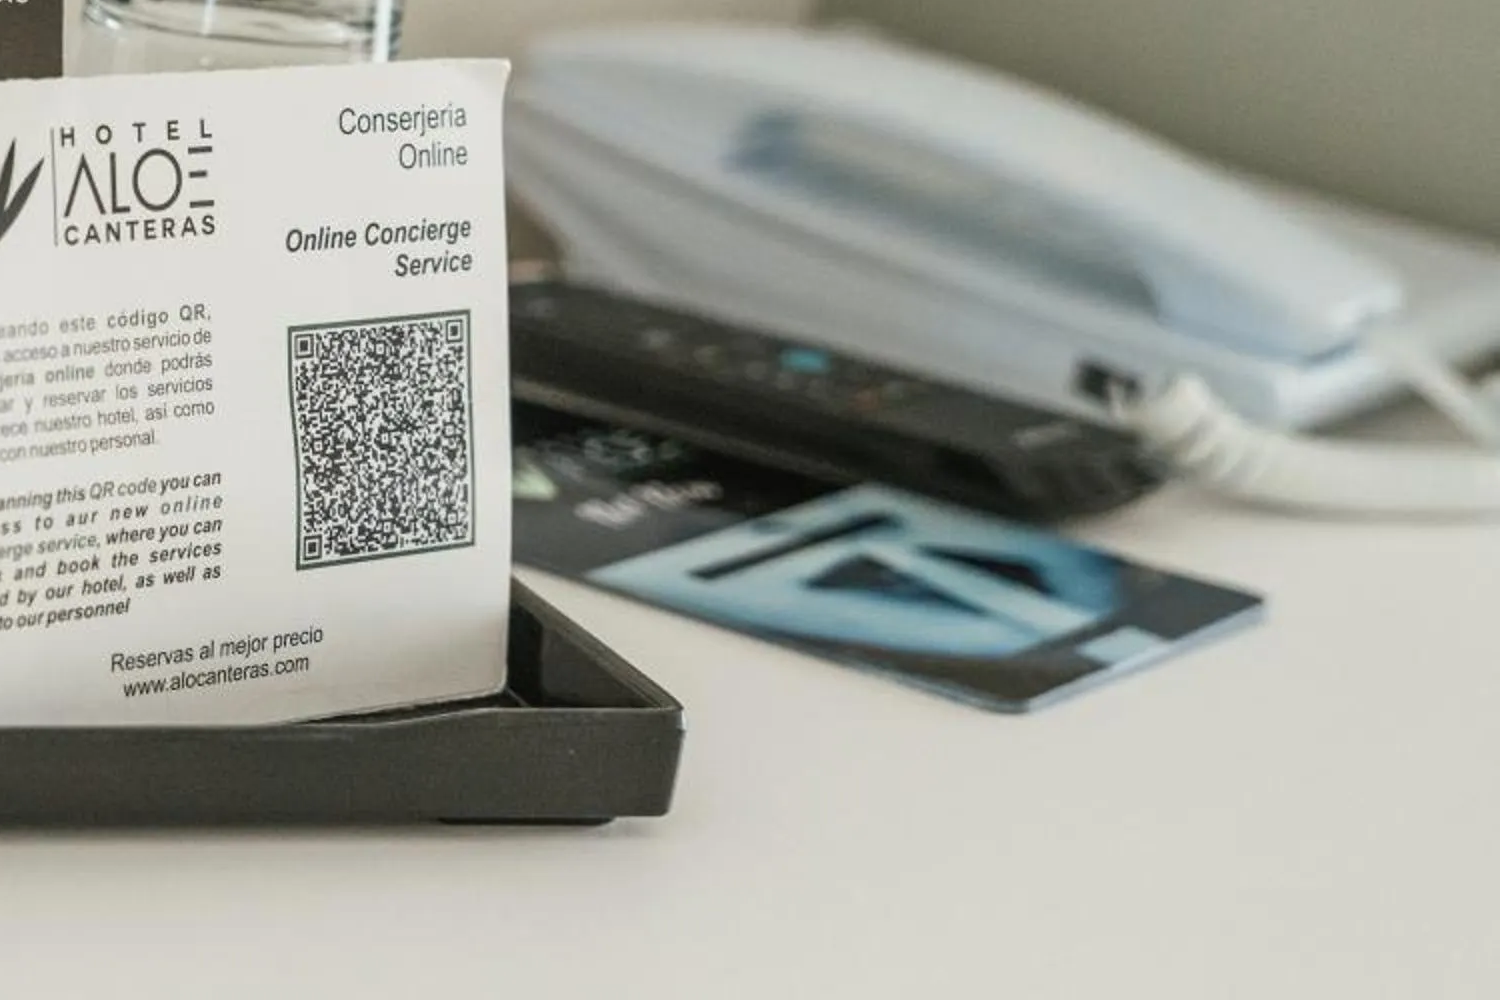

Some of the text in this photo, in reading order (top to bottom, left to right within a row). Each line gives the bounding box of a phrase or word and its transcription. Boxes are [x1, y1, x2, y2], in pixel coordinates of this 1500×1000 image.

[60, 118, 213, 147] HOTEL
[399, 142, 468, 170] Online
[64, 146, 215, 218] ALOE
[64, 215, 216, 246] CANTERAS
[286, 219, 471, 253] Online Concierge
[395, 250, 473, 277] Service
[59, 315, 96, 334] este
[3, 344, 58, 363] acceso
[73, 338, 131, 358] nuestro
[133, 330, 191, 351] servicio
[193, 328, 212, 345] de
[45, 365, 95, 384] online
[104, 358, 152, 378] donde
[161, 352, 213, 374] podrás
[23, 396, 34, 415] y
[43, 388, 107, 408] reservar
[115, 384, 138, 401] los
[147, 376, 213, 398] servicios
[34, 414, 92, 434] nuestro
[173, 400, 215, 418] como
[29, 438, 87, 459] nuestro
[56, 486, 86, 505] this
[89, 481, 115, 500] QR
[117, 477, 157, 497] code
[160, 475, 190, 496] you
[193, 472, 221, 488] can
[35, 514, 54, 532] to
[109, 504, 149, 522] new
[160, 495, 223, 516] online
[106, 526, 155, 546] where
[159, 522, 189, 543] you
[193, 518, 223, 535] can
[14, 562, 46, 581] and
[57, 554, 100, 576] book
[111, 551, 139, 569] the
[149, 541, 223, 563] services
[17, 586, 38, 608] by
[45, 583, 73, 600] our
[135, 573, 155, 590] as
[163, 566, 195, 585] well
[202, 563, 222, 580] as
[16, 611, 44, 630] our
[46, 597, 132, 628] personnel
[111, 624, 324, 673] Reservas al mejor precio
[123, 656, 310, 698] www.alocanteras.com
